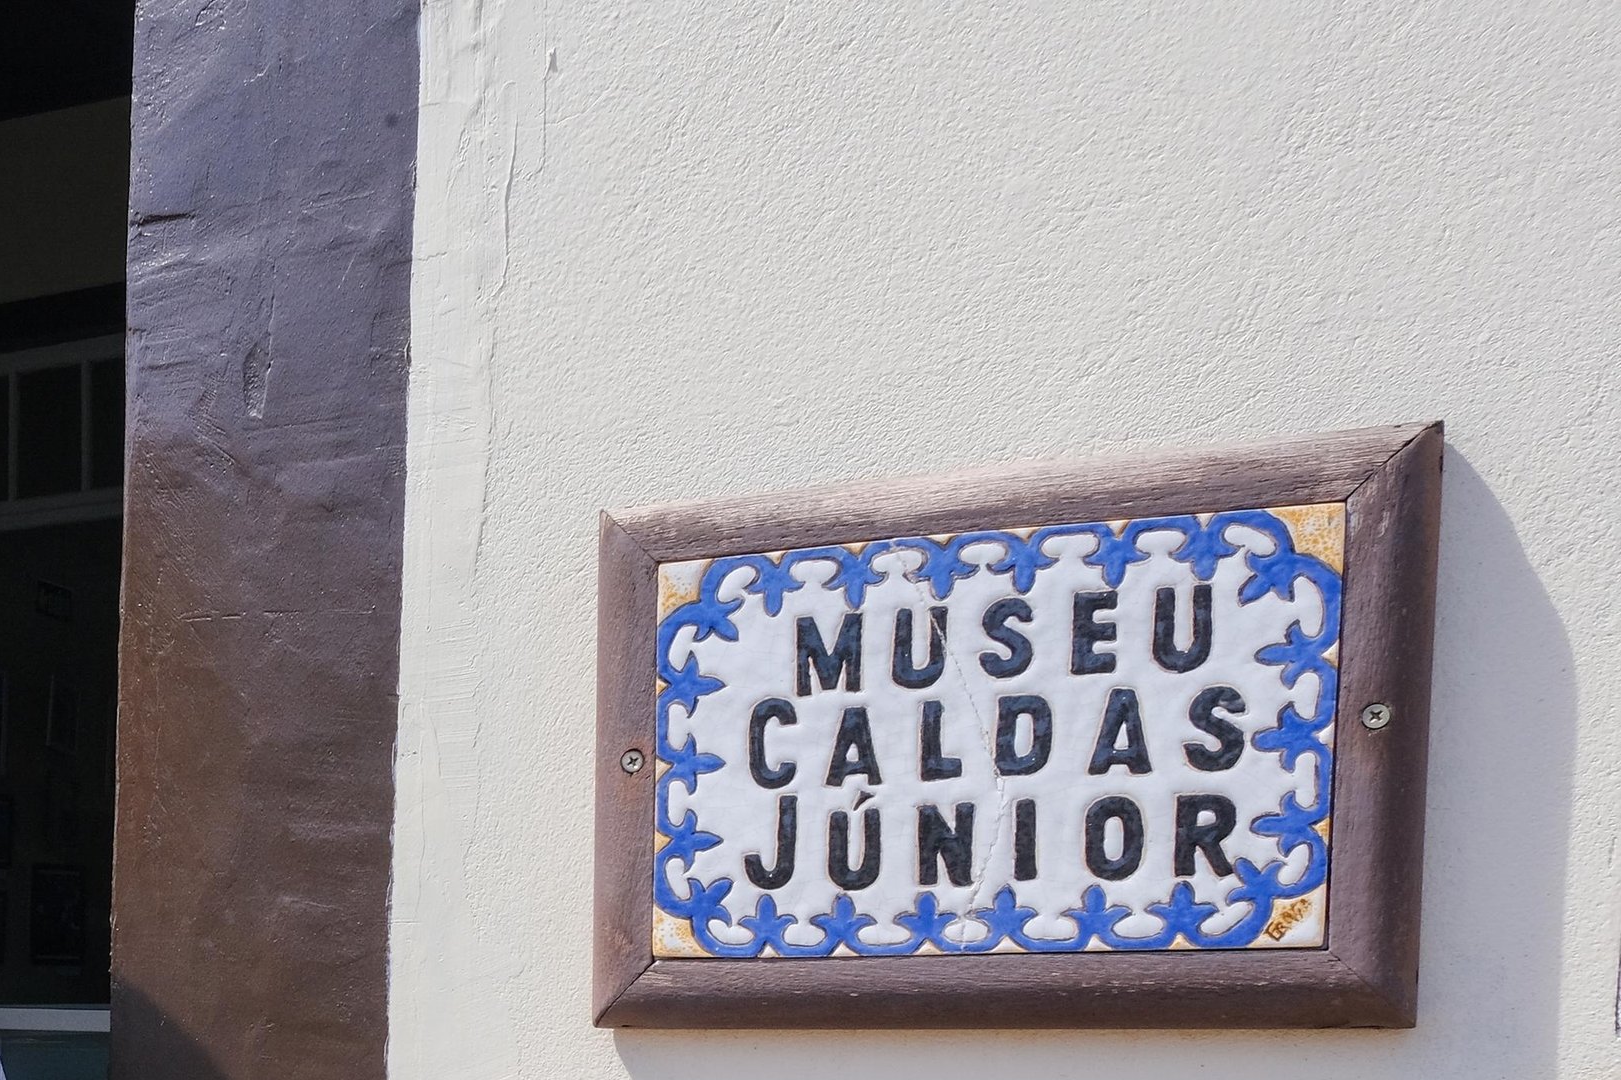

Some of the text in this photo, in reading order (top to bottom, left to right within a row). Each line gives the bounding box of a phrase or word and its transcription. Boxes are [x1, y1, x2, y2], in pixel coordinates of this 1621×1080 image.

[795, 584, 1217, 697] MUSEU
[746, 685, 1248, 790] CALDAS
[743, 791, 1238, 891] JÚNIOR
